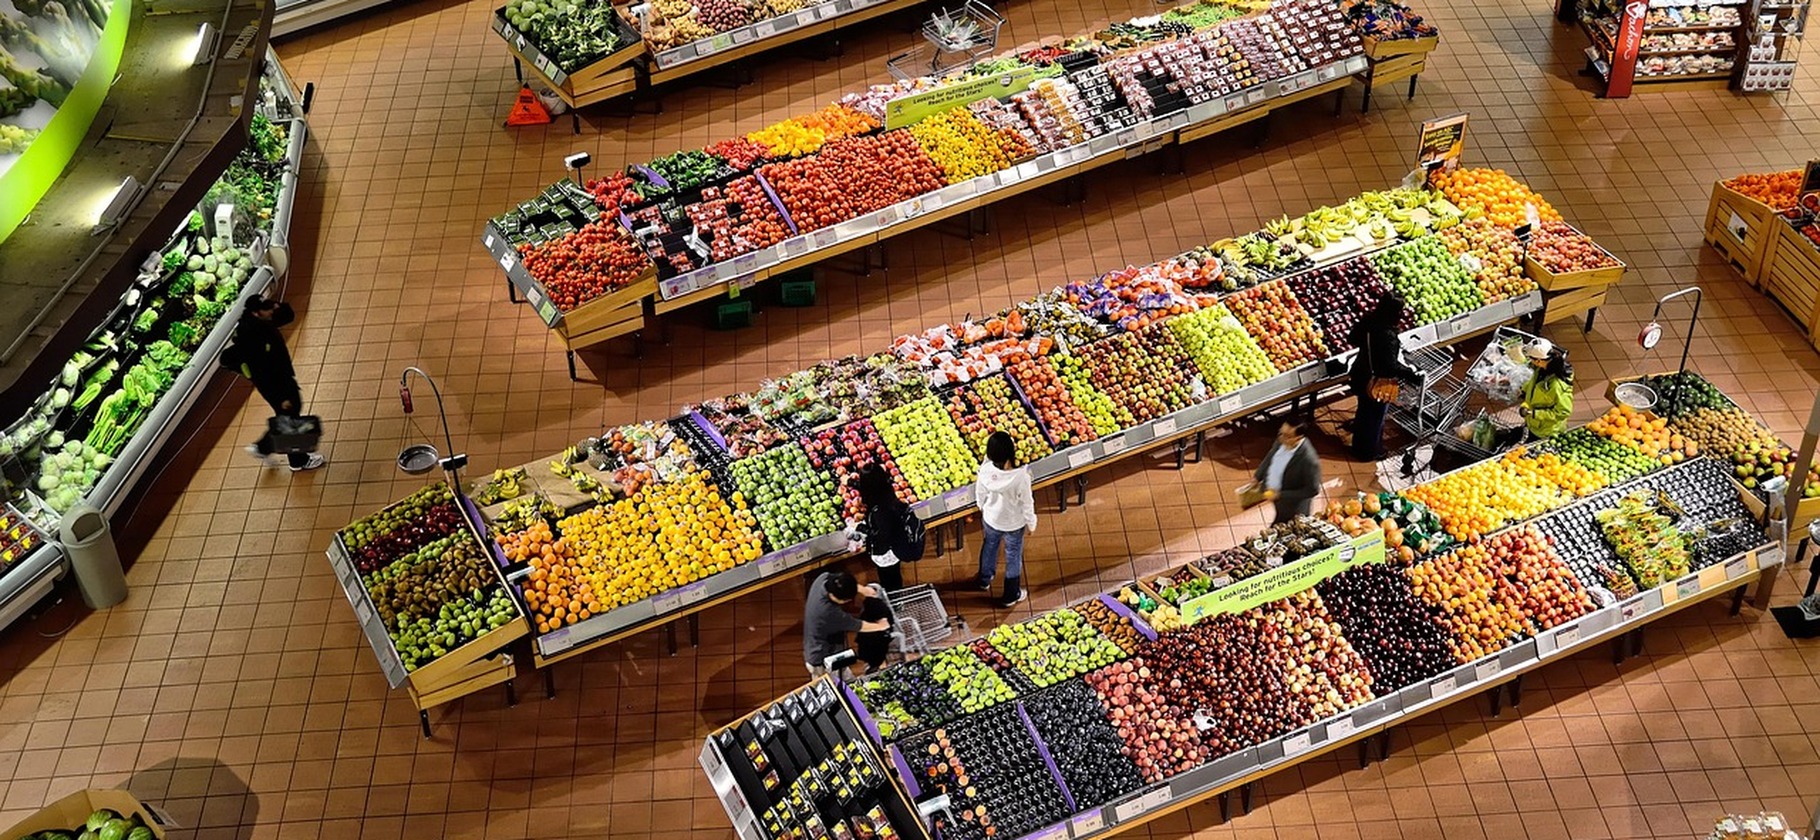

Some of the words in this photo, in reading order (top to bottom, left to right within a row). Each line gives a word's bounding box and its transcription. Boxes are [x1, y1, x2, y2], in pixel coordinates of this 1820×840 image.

[913, 94, 935, 104] Looking
[946, 85, 973, 95] nutritious
[974, 78, 997, 88] choices?
[928, 97, 945, 105] Reach
[966, 87, 983, 96] Stars!
[1218, 586, 1249, 601] Looking
[1263, 567, 1300, 584] nutritious
[1302, 553, 1334, 570] choices?
[1240, 588, 1263, 601] Reach
[1265, 583, 1275, 592] for
[1278, 578, 1290, 587] the
[1292, 568, 1315, 581] Stars!
